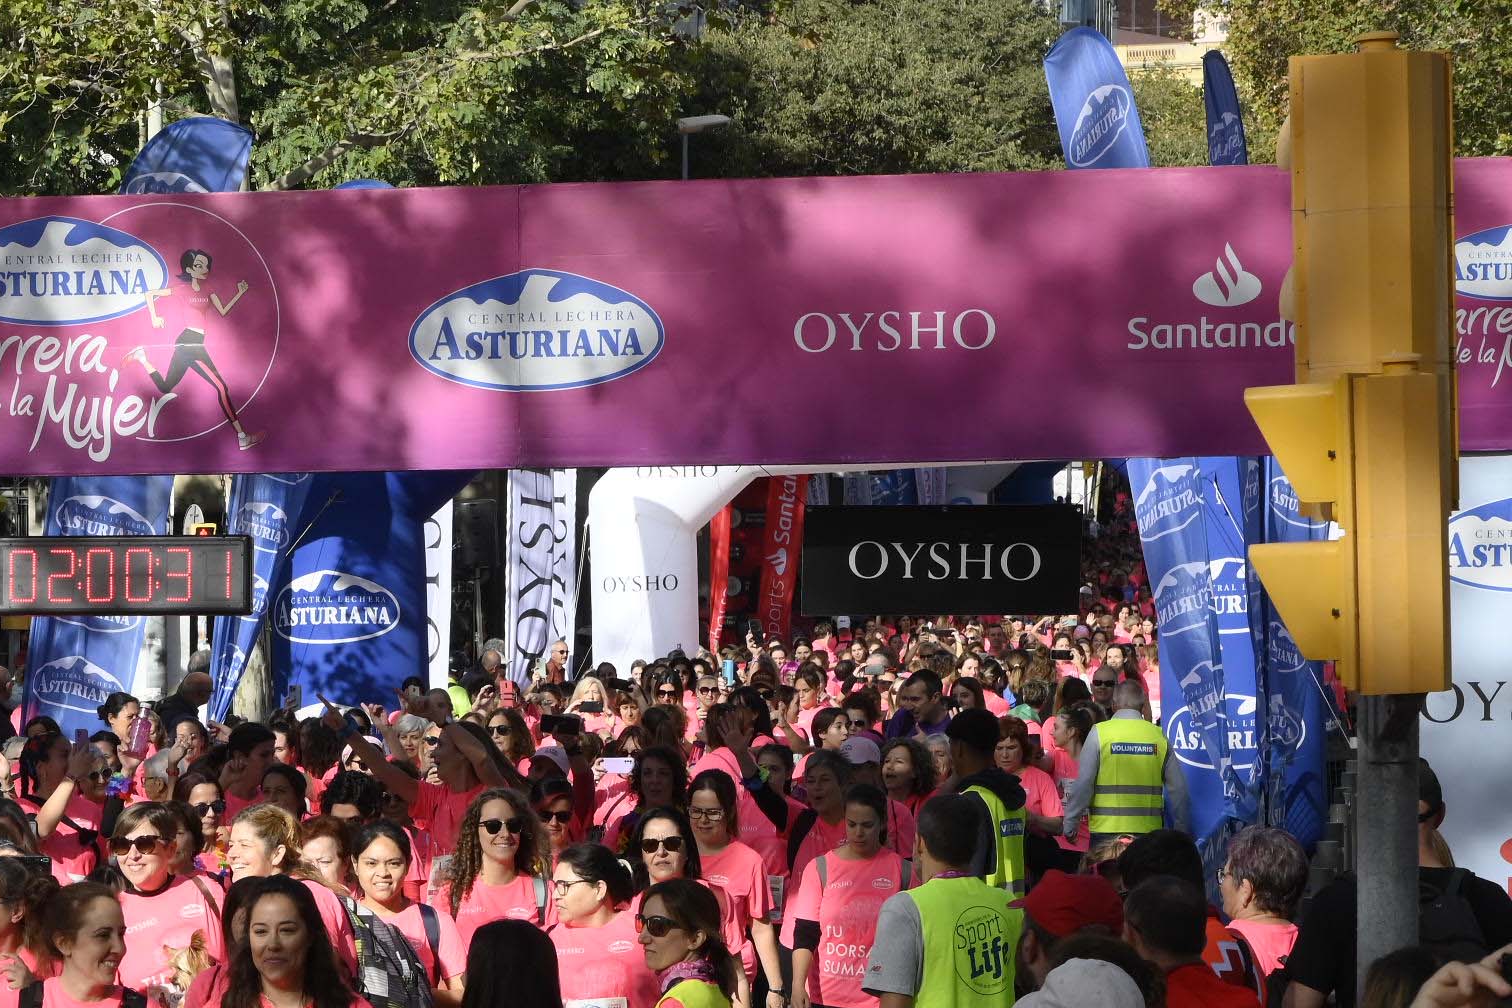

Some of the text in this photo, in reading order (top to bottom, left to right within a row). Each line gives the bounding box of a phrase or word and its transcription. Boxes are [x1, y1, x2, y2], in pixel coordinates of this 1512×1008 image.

[71, 253, 143, 264] LECHERA
[468, 309, 636, 324] CENTRAL LECHERA
[794, 309, 996, 352] OYSHO
[1456, 307, 1512, 335] arre
[429, 316, 644, 361] ASTURIANA
[1128, 317, 1295, 349] Santand
[1478, 336, 1496, 363] la
[10, 379, 34, 417] la
[29, 367, 178, 463] Mujer
[516, 469, 554, 660] OYSH
[848, 541, 1041, 581] OYSHO
[603, 573, 679, 593] OYSHO
[279, 602, 391, 627] ASTURIANA
[291, 596, 333, 604] CENTRAL
[768, 577, 784, 635] ports
[37, 671, 111, 703] ASTURIAN
[1111, 744, 1154, 753] VOLUNTARIS
[826, 925, 843, 938] TU
[956, 912, 1003, 949] Sport
[827, 943, 873, 958] DORSA
[968, 936, 1009, 980] Life
[824, 960, 866, 976] SUMA
